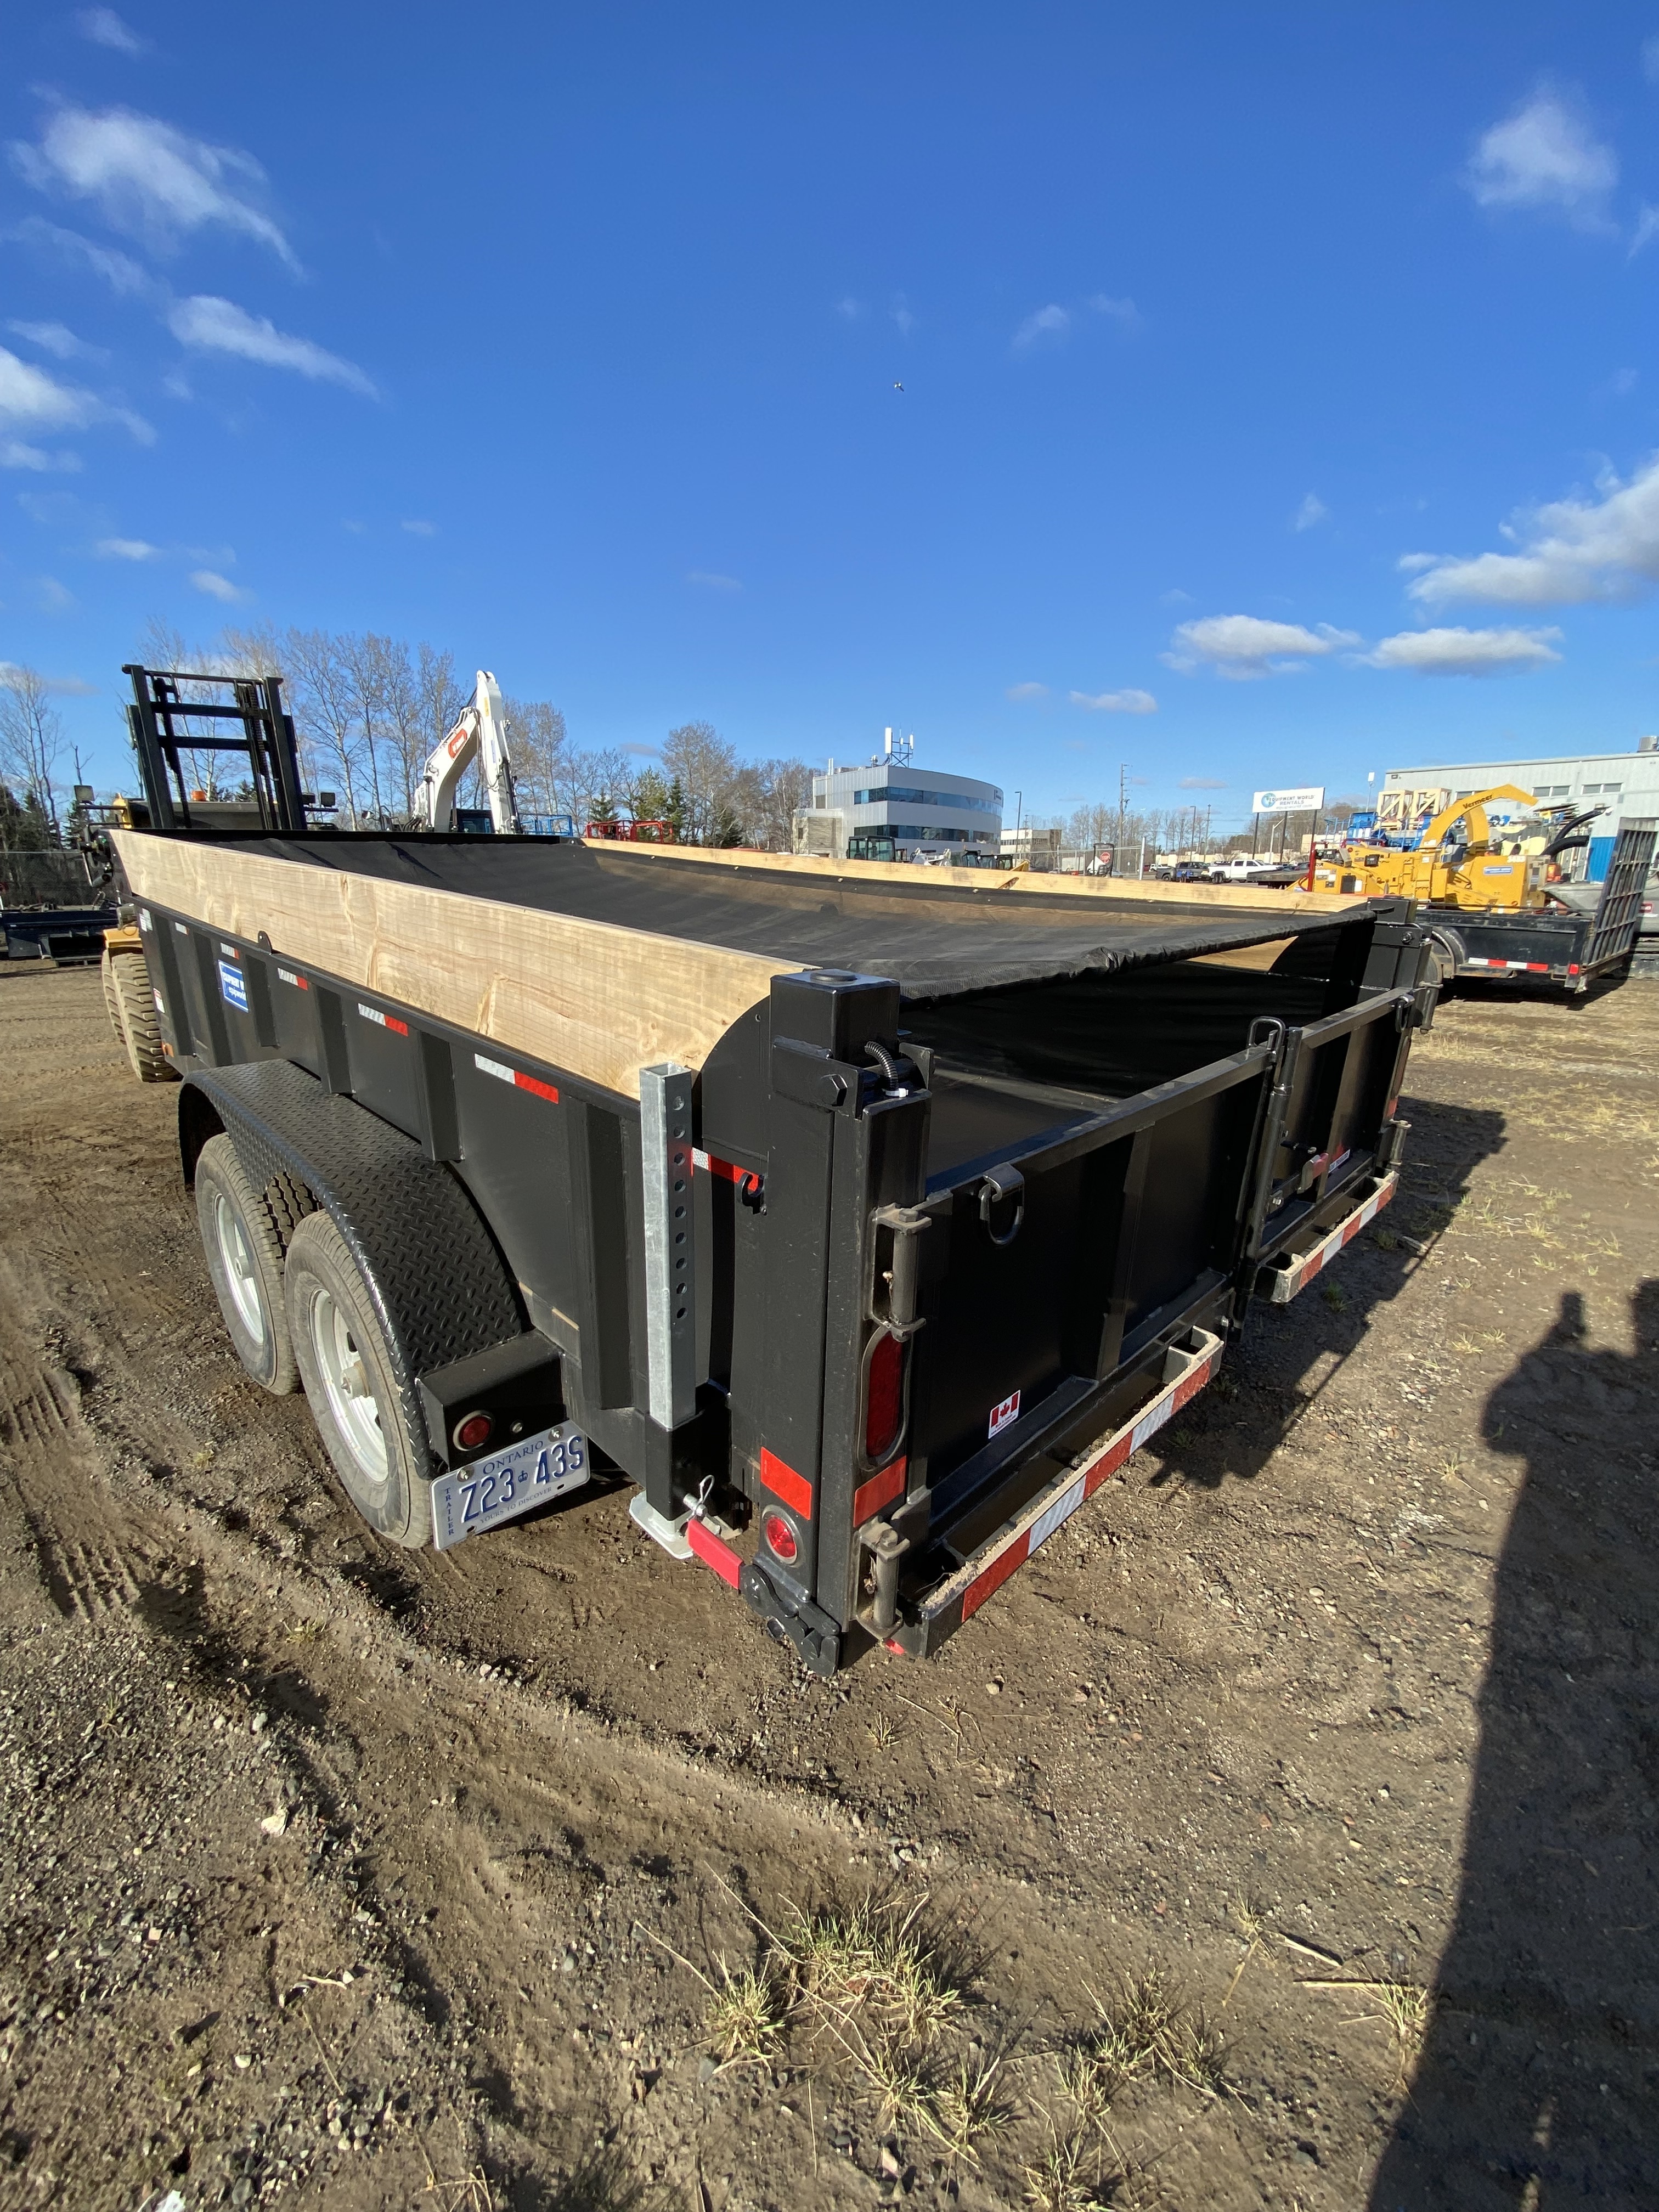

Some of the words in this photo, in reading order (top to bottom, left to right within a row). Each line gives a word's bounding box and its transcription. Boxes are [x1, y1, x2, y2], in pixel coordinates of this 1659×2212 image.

[1463, 794, 1492, 809] Vermeer
[483, 1441, 543, 1475] ONTARIO
[445, 1487, 454, 1536] TRAILER
[459, 1468, 515, 1523] Z23
[480, 1510, 504, 1523] YOURS
[507, 1503, 516, 1511] TO
[518, 1487, 552, 1506] DISCOVER
